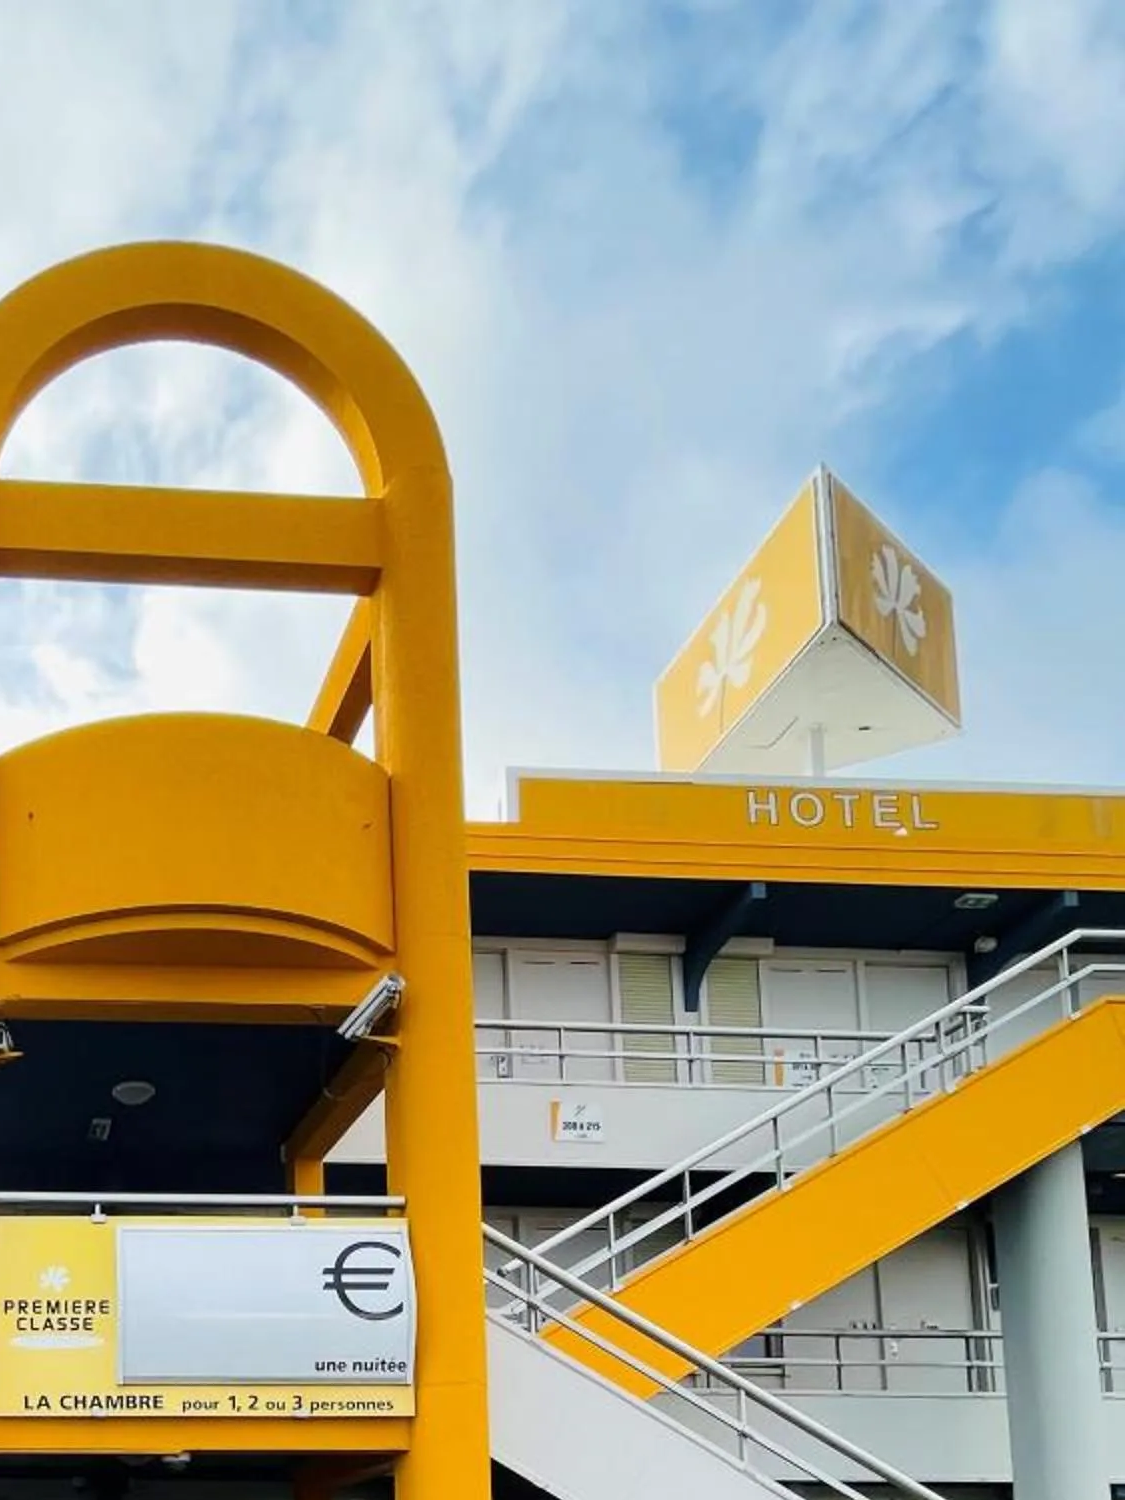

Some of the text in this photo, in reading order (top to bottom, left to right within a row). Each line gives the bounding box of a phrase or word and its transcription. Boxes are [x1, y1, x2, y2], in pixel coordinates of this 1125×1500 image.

[747, 790, 939, 829] HOTEL
[3, 1299, 111, 1315] PREMIERE
[16, 1317, 94, 1331] CLASSE
[314, 1357, 407, 1373] une nuitée
[23, 1394, 395, 1414] LA CHAMBRE pour 1, 2 ou 3 personnes
